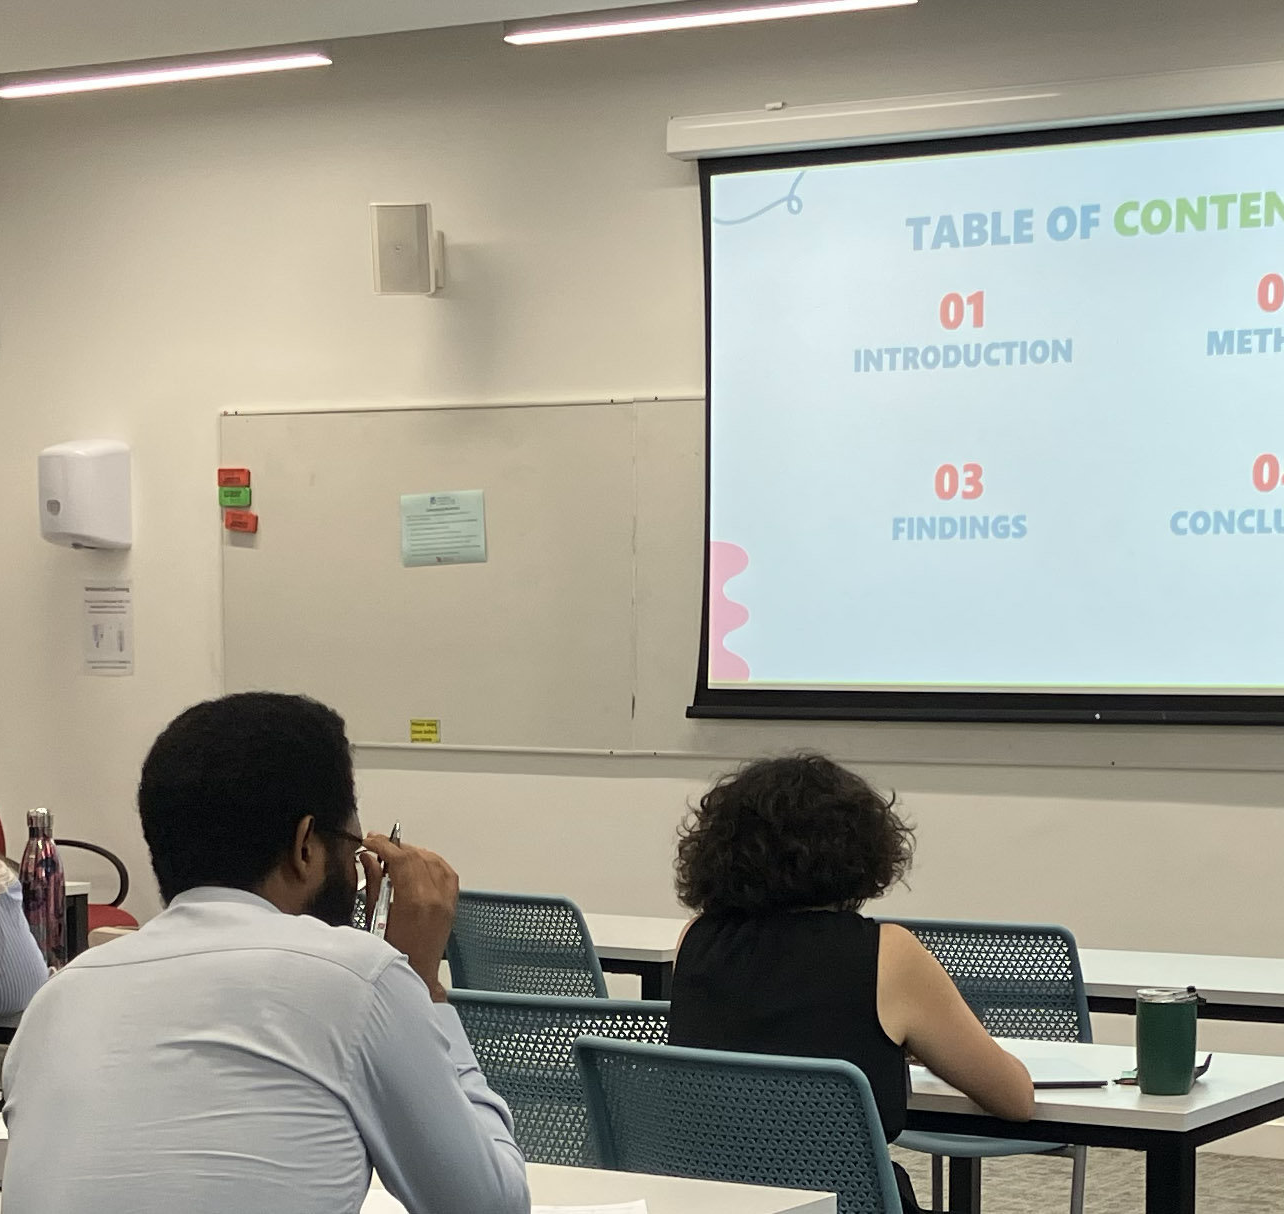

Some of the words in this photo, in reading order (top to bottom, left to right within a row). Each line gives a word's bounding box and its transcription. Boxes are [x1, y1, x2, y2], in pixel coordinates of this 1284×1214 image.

[905, 207, 1035, 251] TABLE
[1046, 203, 1101, 242] OF
[939, 290, 986, 331] 01
[853, 338, 1073, 373] INTRODUCTION
[933, 462, 984, 501] 03
[891, 515, 1028, 541] FINDINGS
